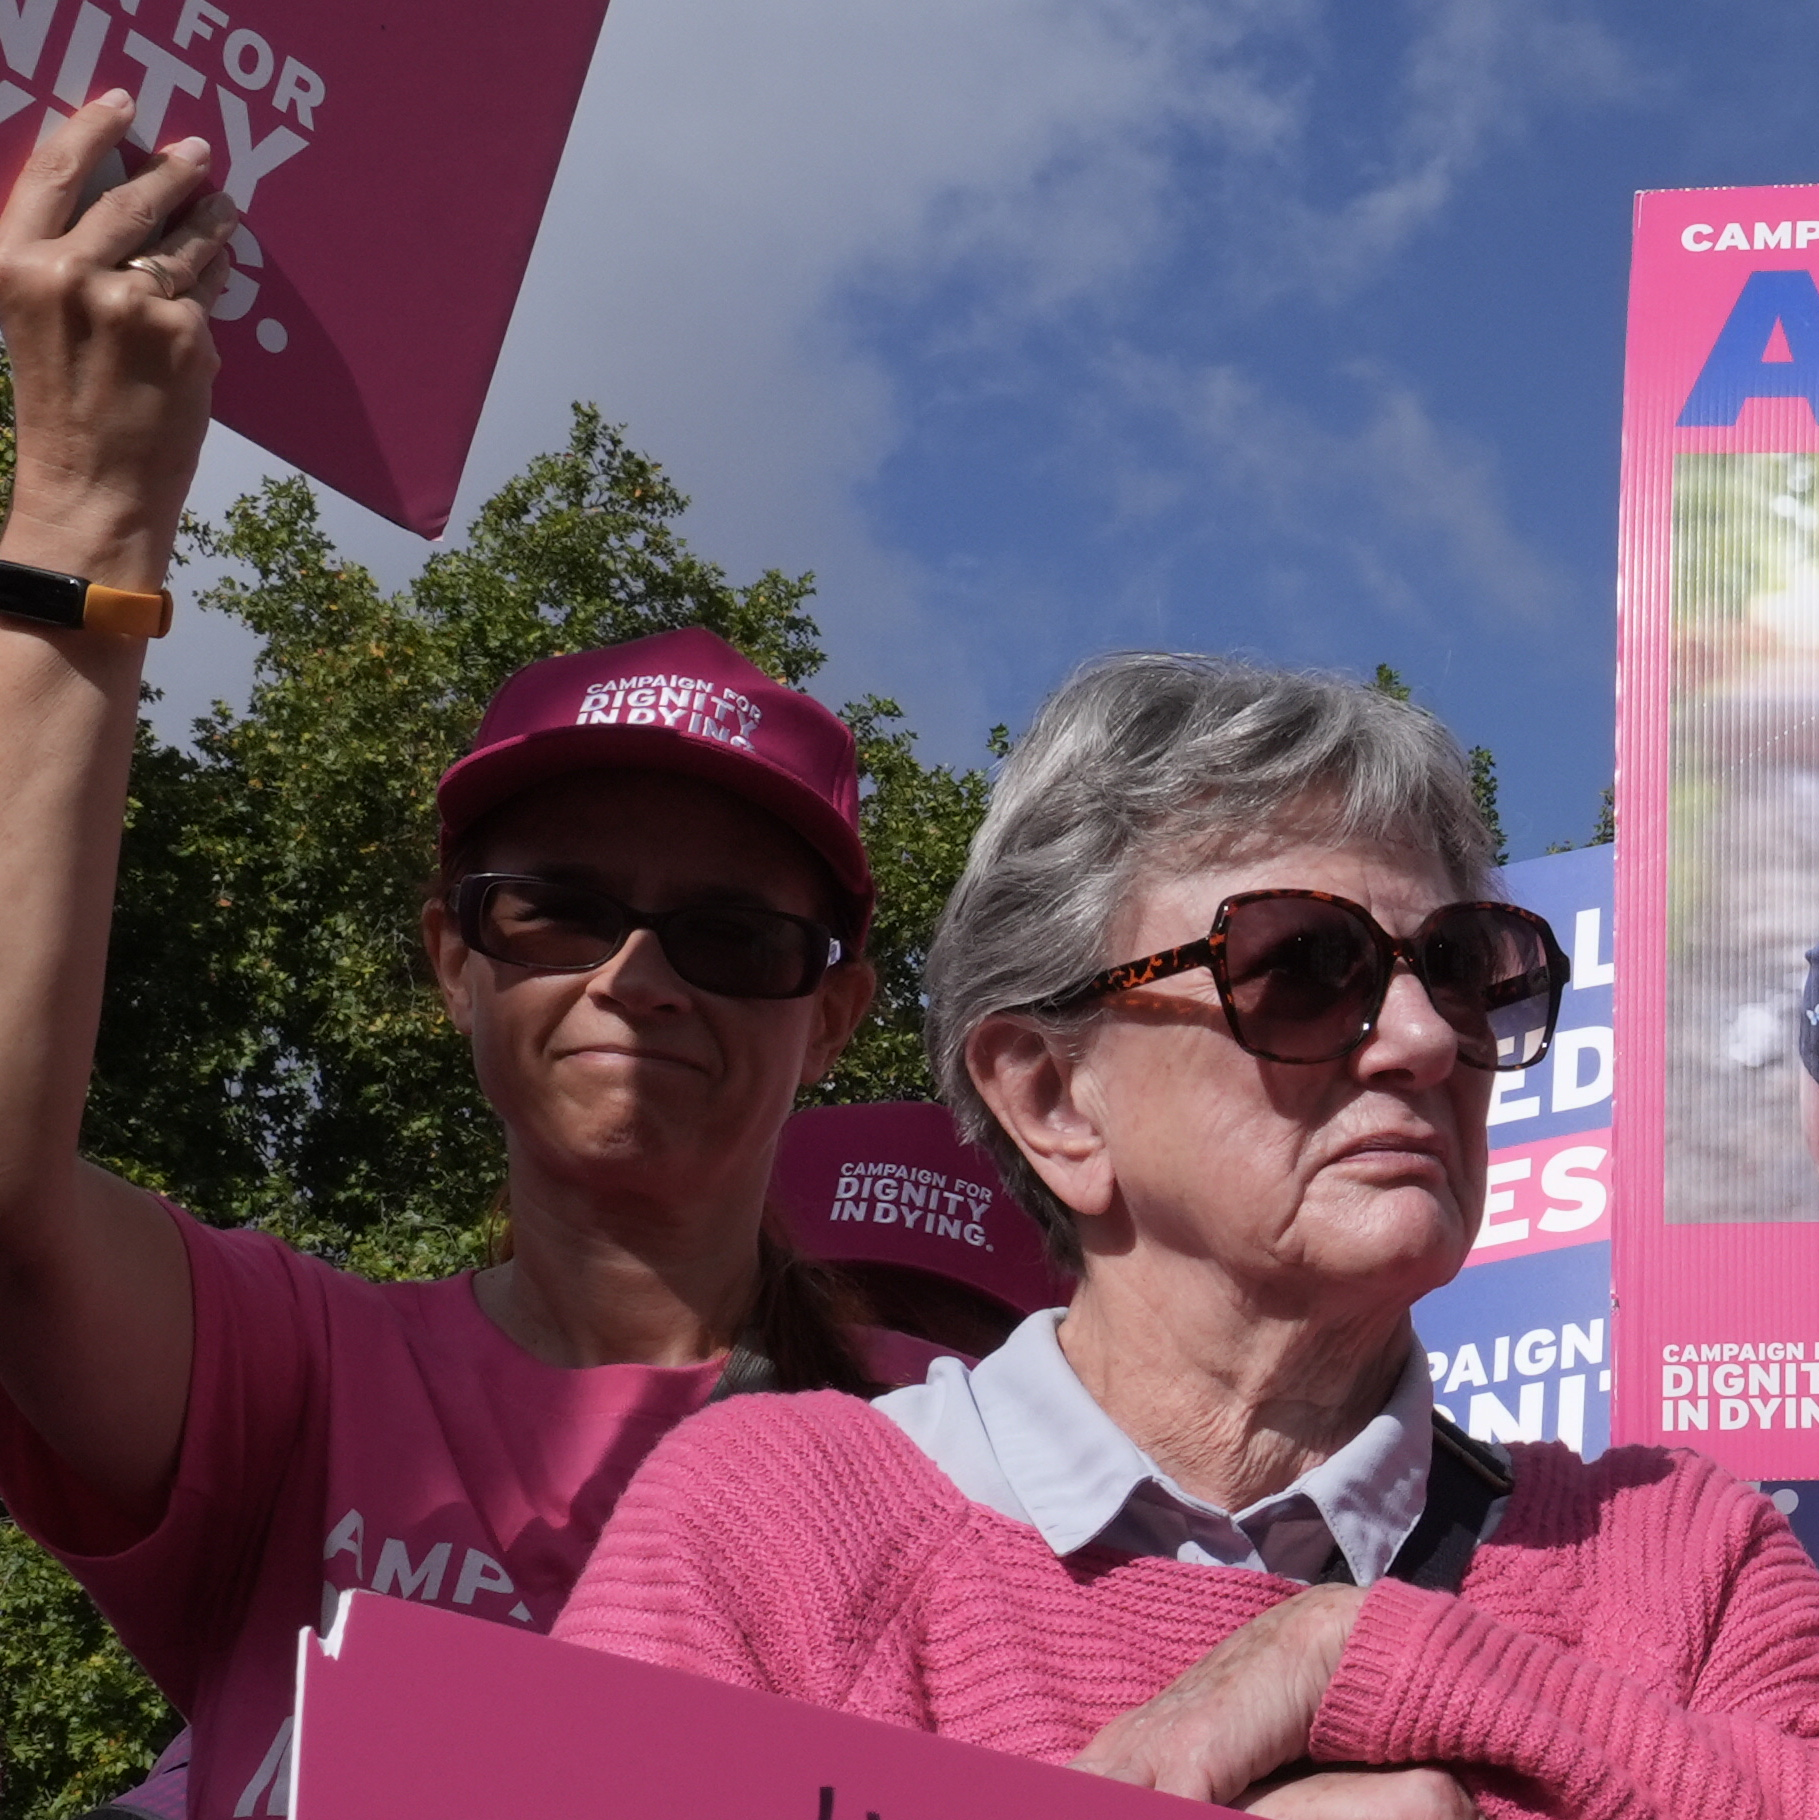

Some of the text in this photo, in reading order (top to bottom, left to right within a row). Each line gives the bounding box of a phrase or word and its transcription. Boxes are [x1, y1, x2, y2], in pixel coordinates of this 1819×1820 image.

[172, 0, 326, 131] FOR
[576, 709, 619, 725] IN
[579, 687, 759, 738] DIGNITY
[587, 674, 762, 720] CAMPAIGN FOR
[835, 1177, 991, 1222] DIGNITY
[840, 1162, 992, 1202] CAMPAIGN FOR
[829, 1201, 994, 1252] IN DYING.
[1662, 1342, 1804, 1363] CAMPAIGN
[1662, 1399, 1709, 1432] IN
